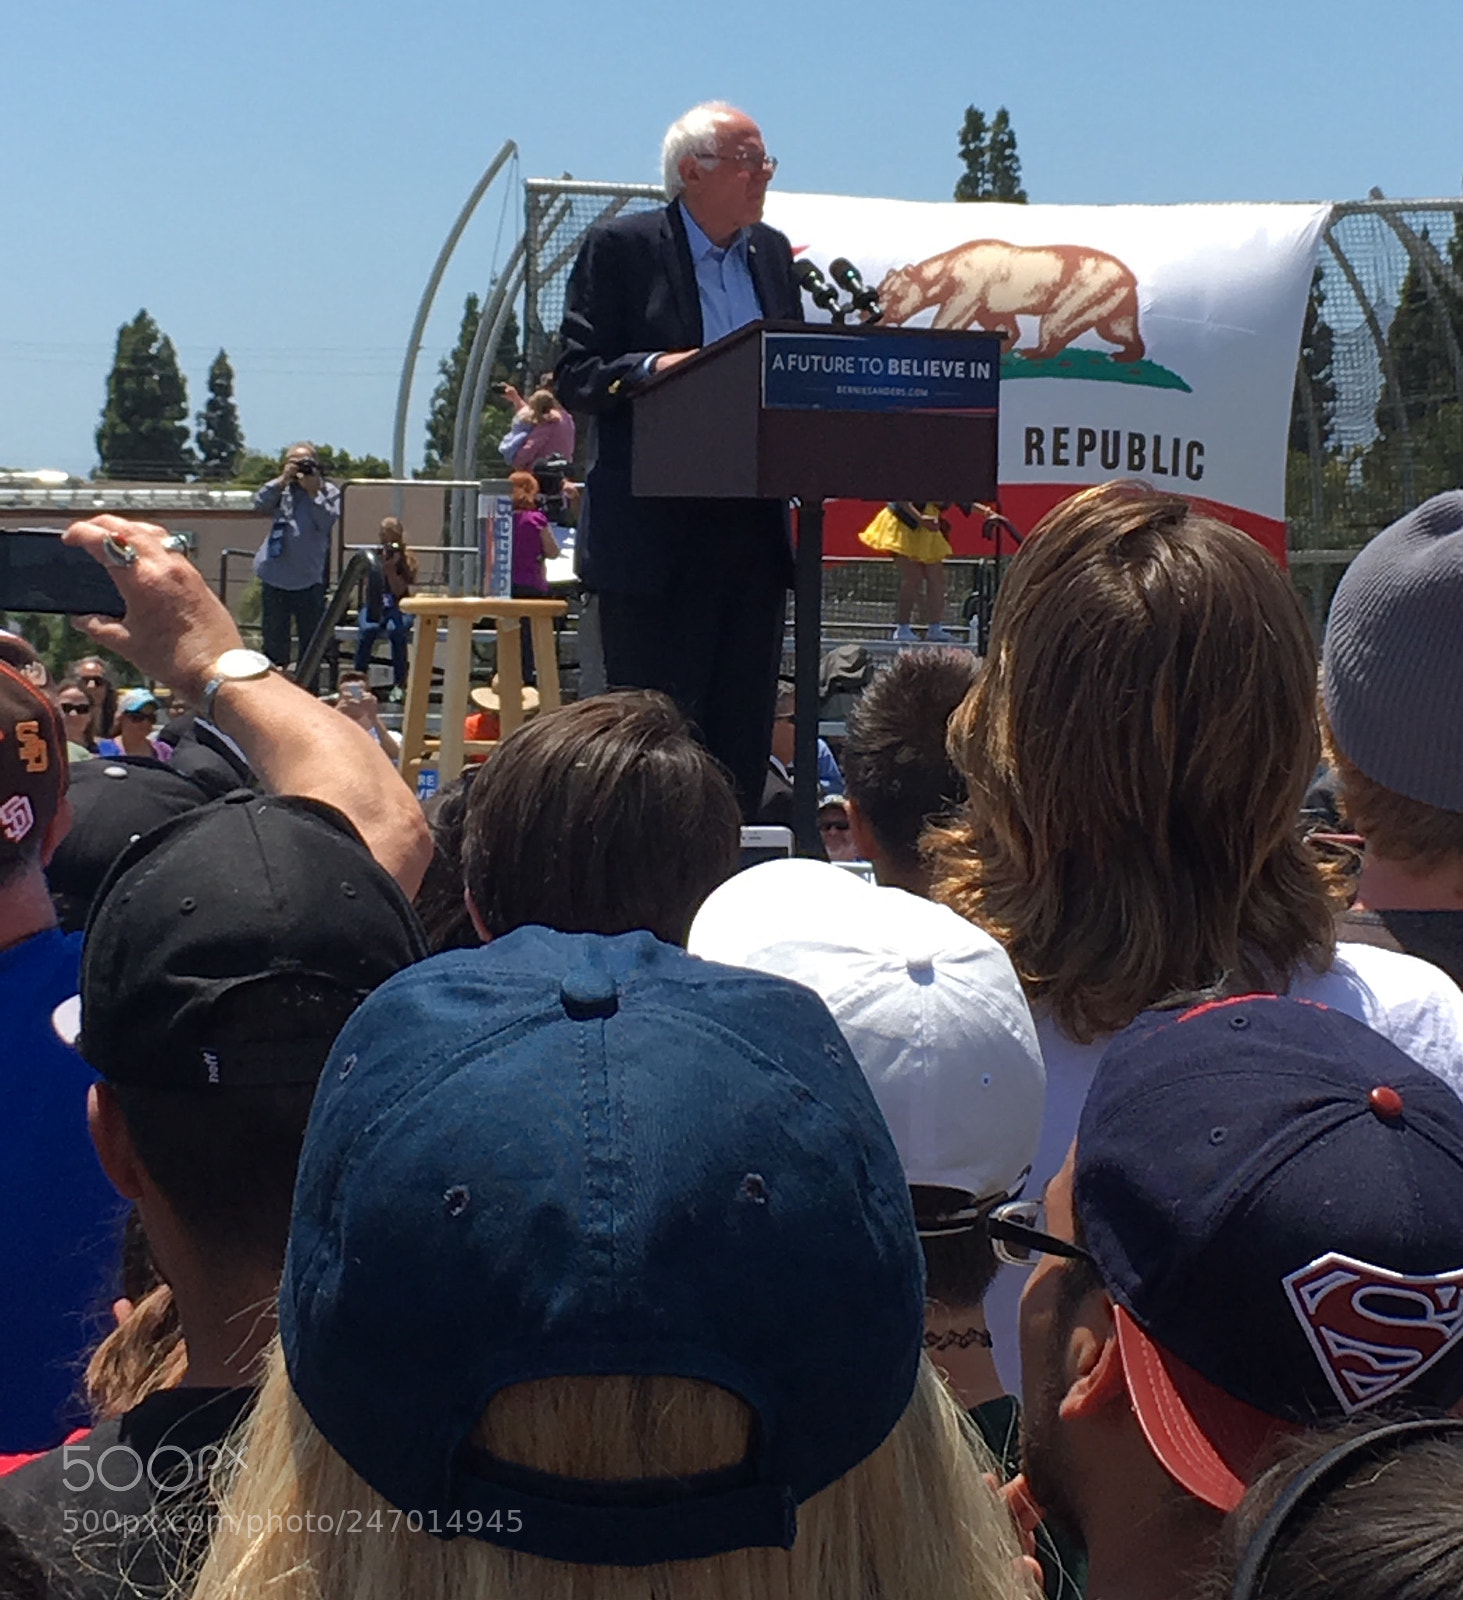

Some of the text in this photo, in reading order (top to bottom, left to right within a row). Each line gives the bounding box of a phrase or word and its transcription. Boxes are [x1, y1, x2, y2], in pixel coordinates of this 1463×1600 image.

[772, 353, 990, 380] A FUTURE TO BELIEVE IN
[1025, 427, 1205, 481] REPUBLIC
